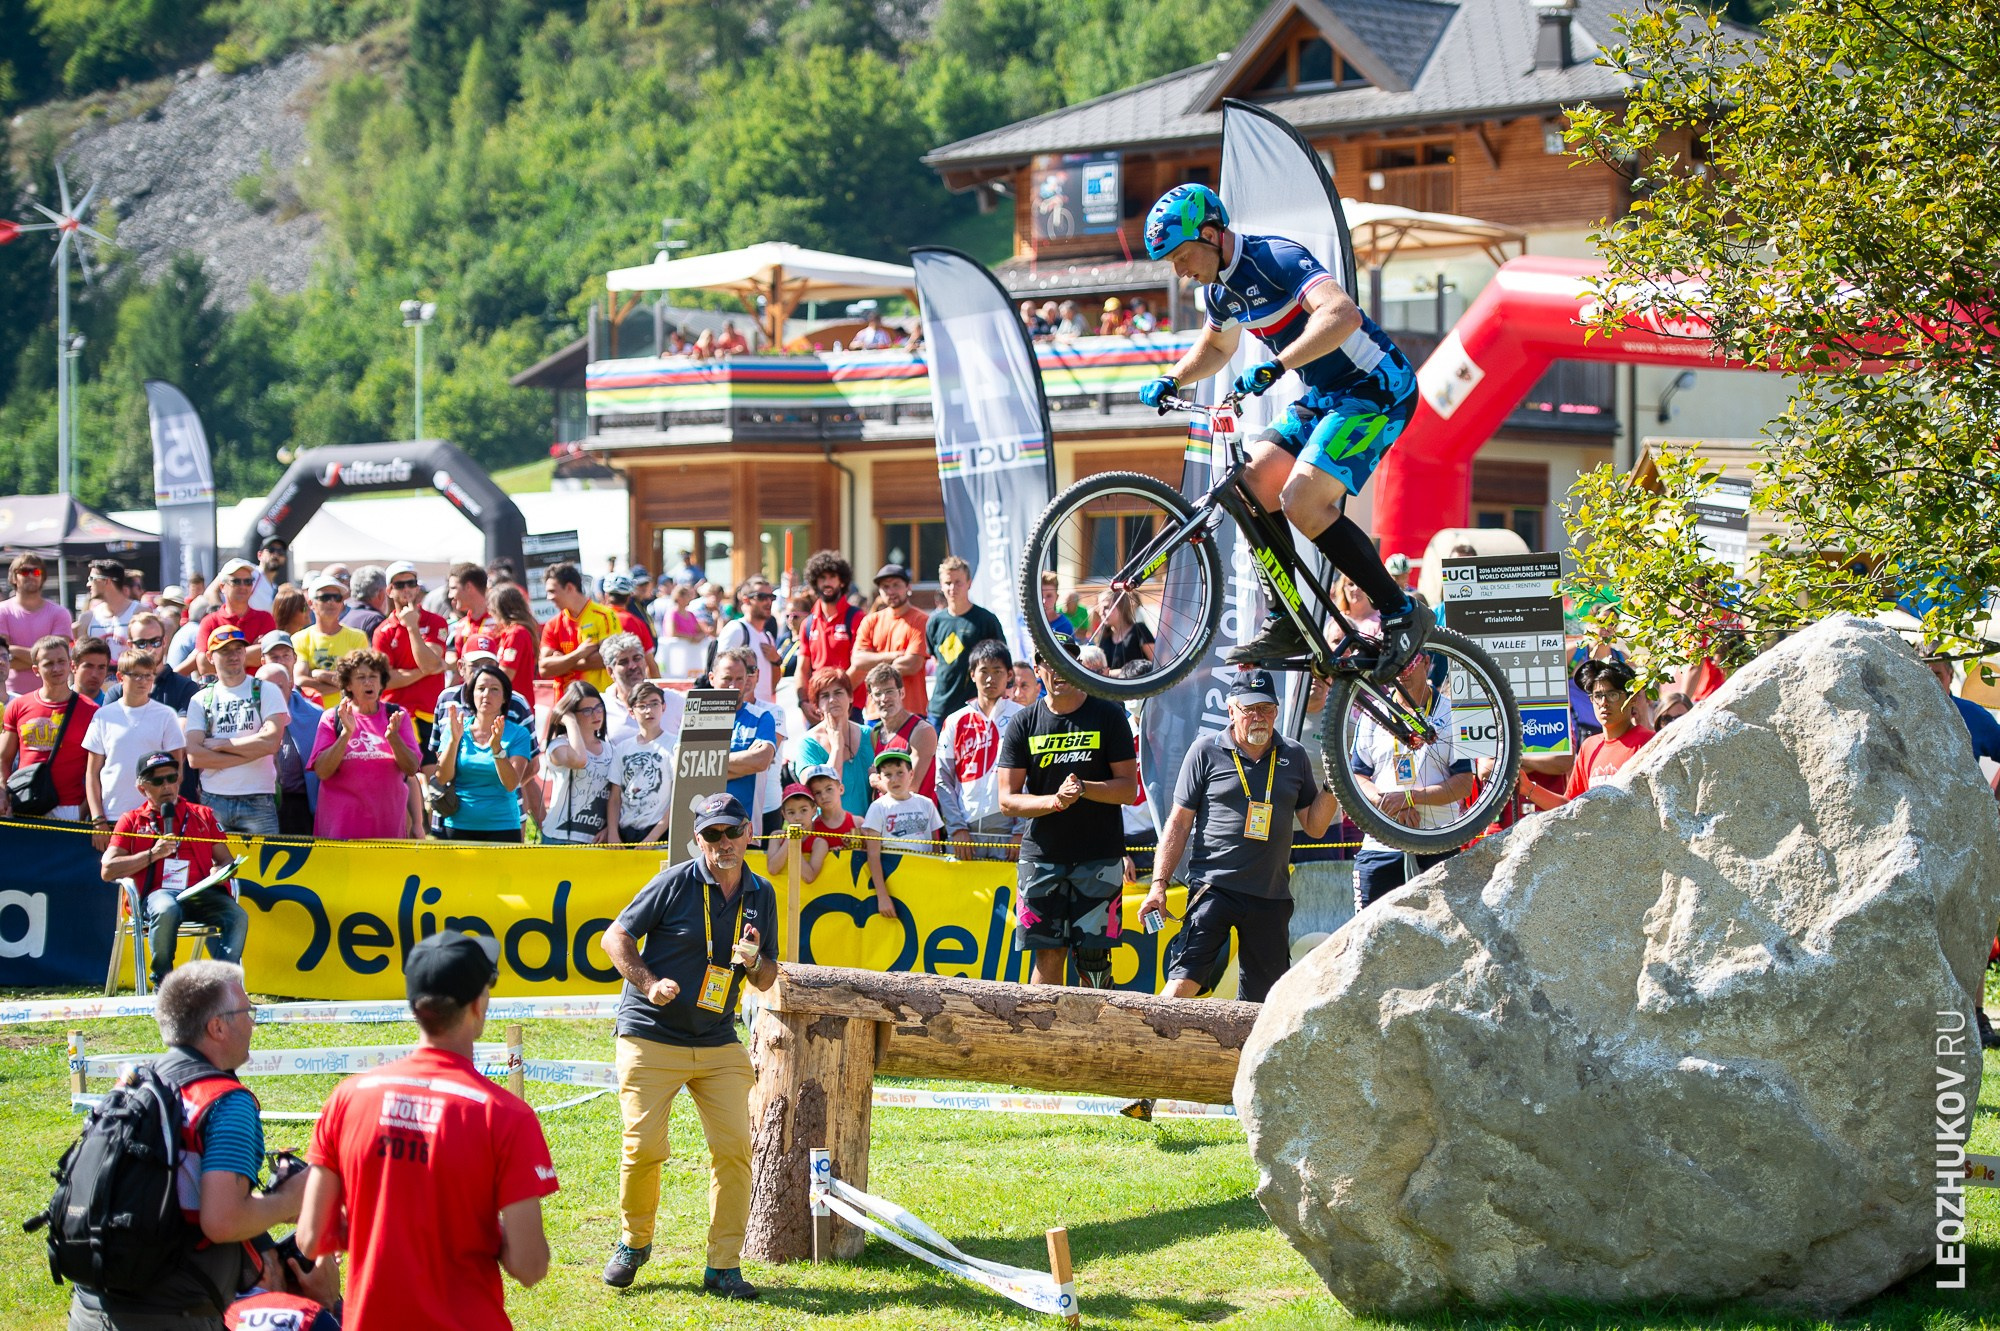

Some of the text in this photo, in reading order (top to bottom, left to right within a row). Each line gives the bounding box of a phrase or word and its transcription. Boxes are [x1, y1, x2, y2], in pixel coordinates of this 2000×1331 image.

[1448, 569, 1475, 581] UCI
[1491, 565, 1521, 573] MOUNTAIN
[1500, 571, 1546, 579] CHAMPIONSHIPS
[1485, 615, 1524, 623] #TrialsWorlds
[1492, 639, 1559, 649] VALLEE FRA
[1513, 656, 1520, 666] 3
[1532, 655, 1540, 665] 4
[1553, 654, 1559, 664] 5
[688, 700, 699, 711] UCI
[1469, 725, 1497, 740] UC
[1522, 721, 1565, 736] RENTINO
[679, 749, 727, 778] START
[382, 1100, 443, 1124] WORLD
[377, 1134, 430, 1165] 2016
[249, 1312, 297, 1328] UCI
